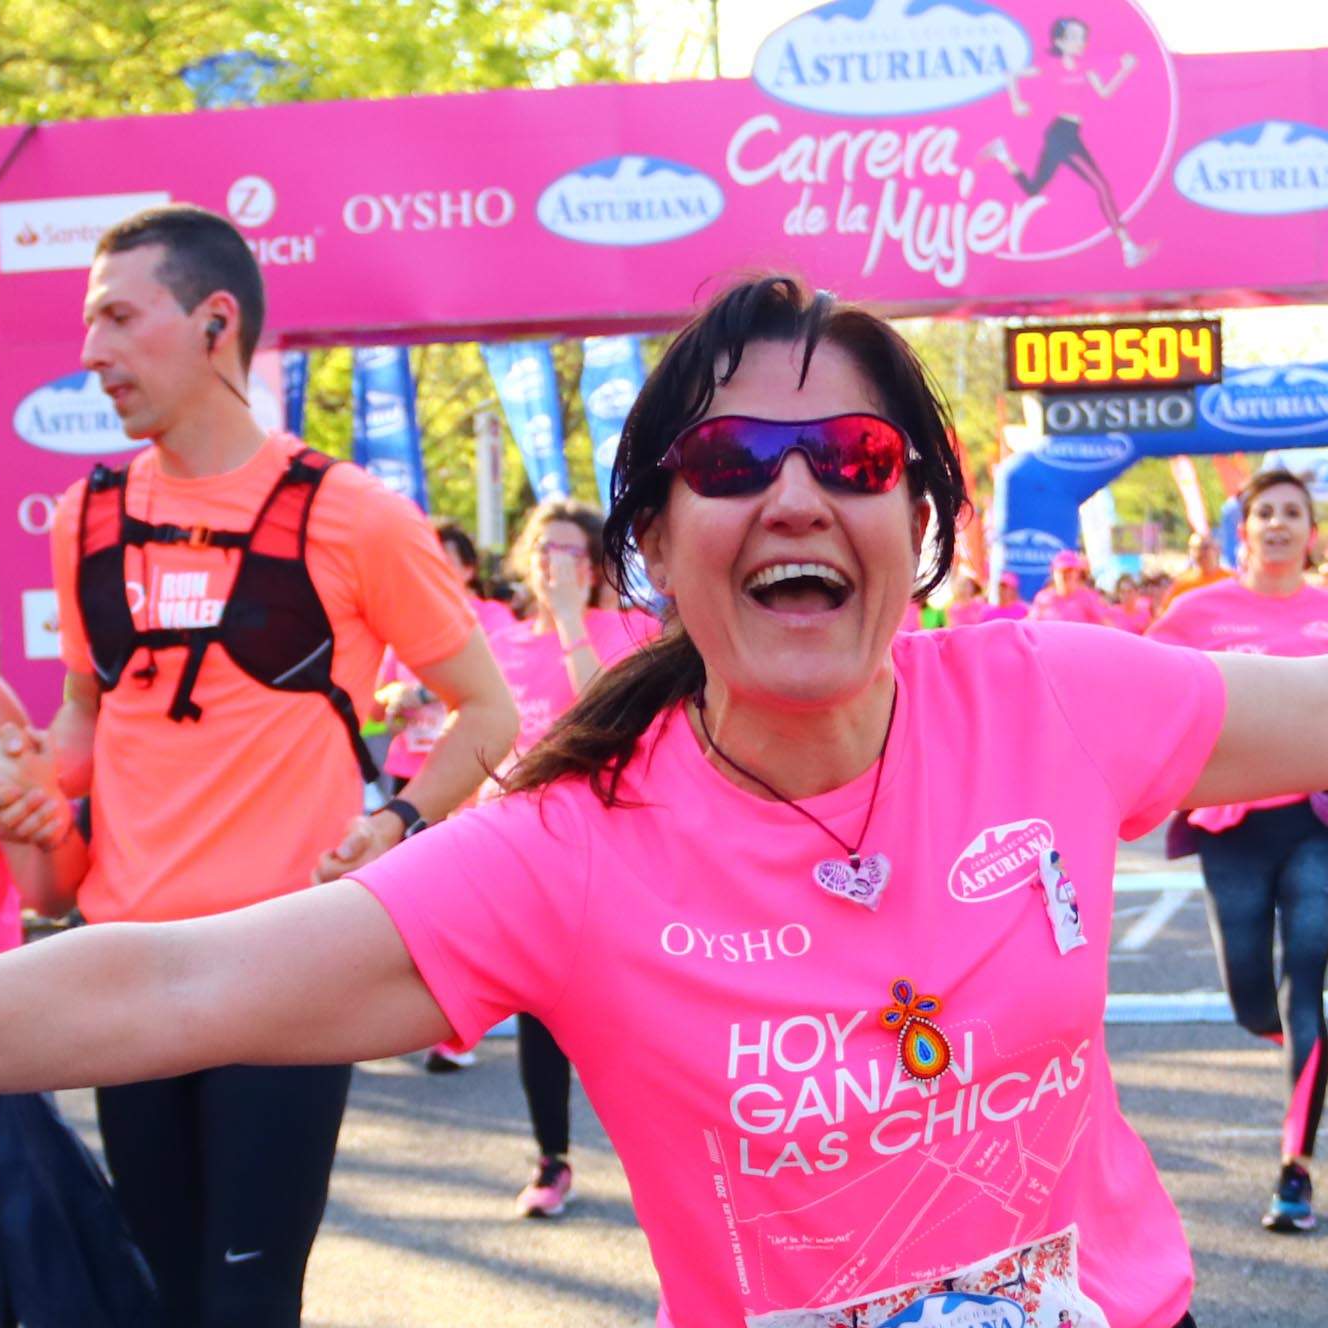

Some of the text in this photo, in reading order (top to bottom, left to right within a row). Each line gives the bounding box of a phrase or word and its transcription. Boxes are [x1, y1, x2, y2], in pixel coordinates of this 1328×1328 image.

[774, 39, 1009, 87] ASTURIANA
[725, 113, 962, 186] Carrera
[342, 186, 515, 234] OYSHO
[548, 191, 712, 226] ASTURIANA
[785, 168, 1049, 287] de la Mujer
[1046, 396, 1193, 431] OYSHO
[959, 832, 1051, 898] ASTURIANA
[660, 922, 812, 963] OYSHO
[727, 1009, 867, 1079] HOY
[739, 1038, 1091, 1178] LAS CHICAS
